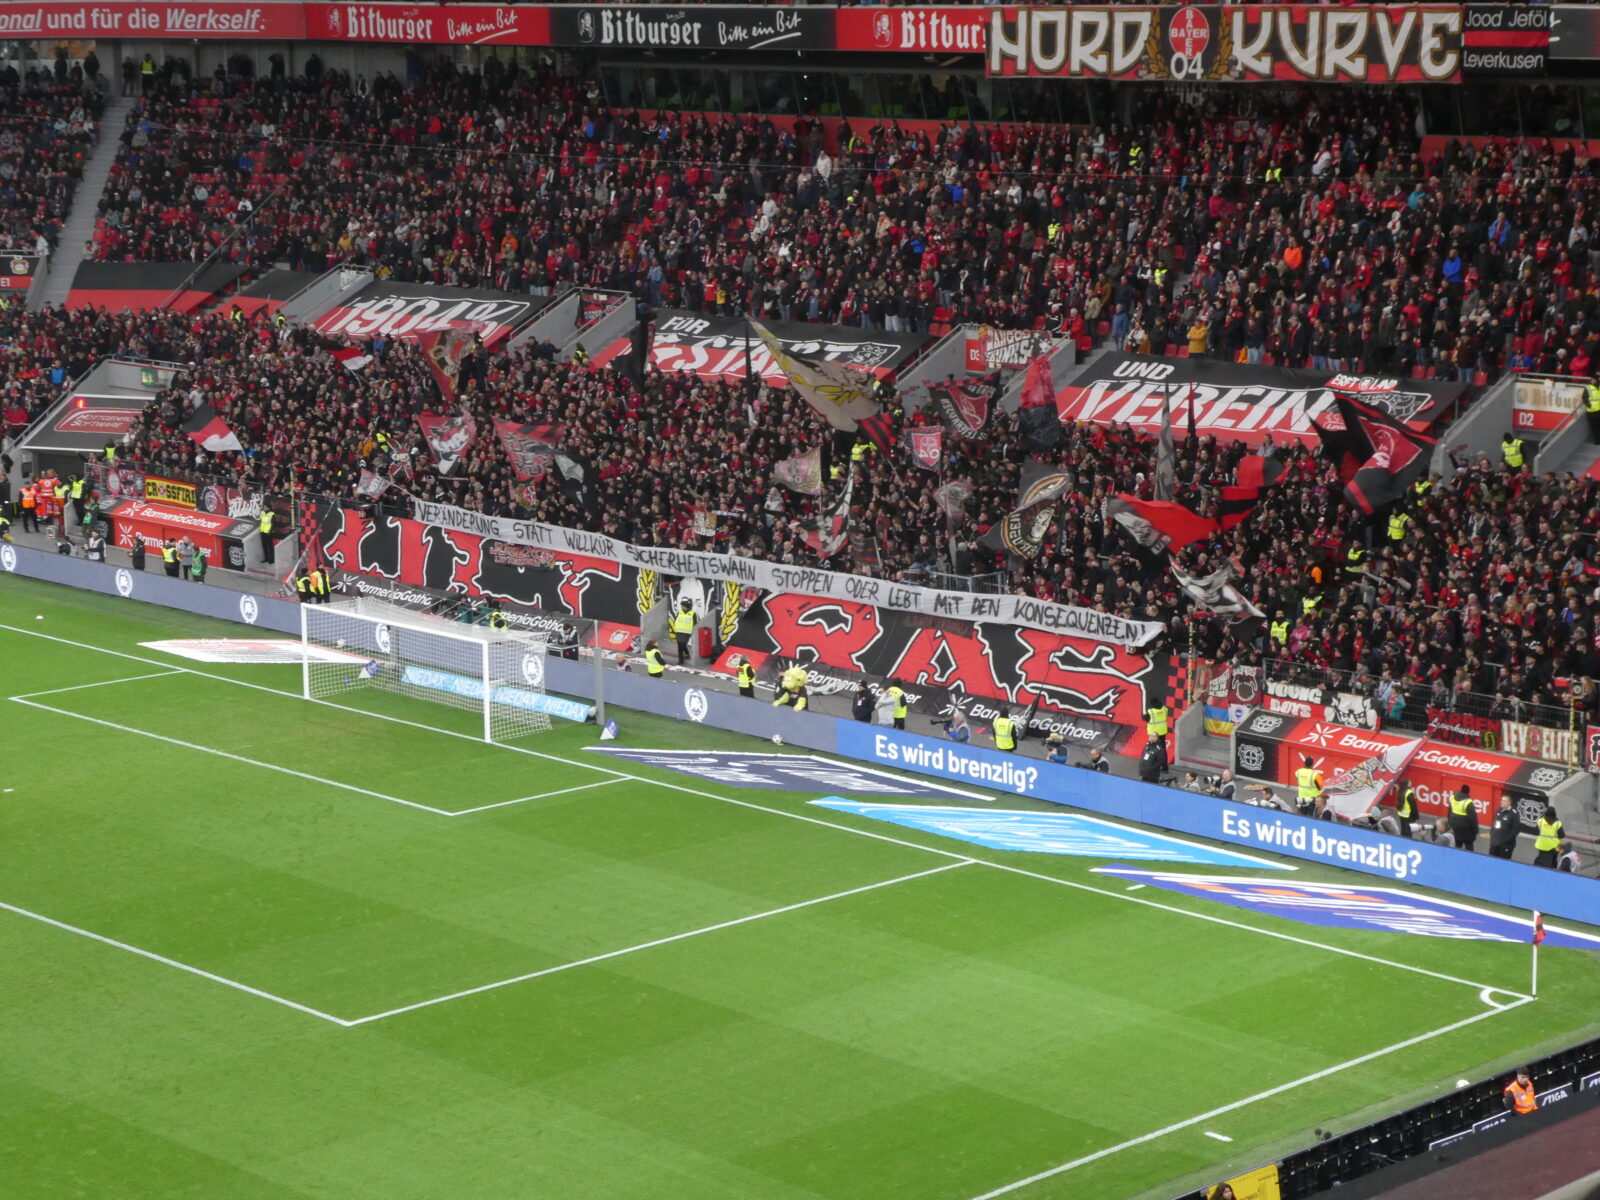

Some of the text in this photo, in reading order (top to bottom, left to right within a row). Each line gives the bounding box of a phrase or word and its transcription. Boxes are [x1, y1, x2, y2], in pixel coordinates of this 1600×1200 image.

[47, 9, 85, 30] und
[91, 8, 122, 29] für
[128, 9, 160, 30] die
[347, 7, 432, 40] Bitburger
[447, 8, 518, 40] Bitte ein Bit
[601, 9, 702, 45] Bitburger
[718, 10, 802, 45] Bitte ein Bit
[1170, 52, 1204, 80] 04
[1463, 52, 1544, 70] Leverkusen
[660, 316, 711, 335] FÜR
[1112, 361, 1176, 381] UND
[417, 502, 500, 537] VERÄNDERUNG
[512, 521, 553, 546] STATT
[770, 567, 835, 594] STOPPEN
[845, 577, 880, 601] ODER
[887, 586, 923, 609] LEBT
[970, 597, 1000, 617] DEN
[1265, 680, 1322, 705] YOUNG
[1270, 698, 1312, 718] BOYS
[875, 734, 899, 761] Es
[902, 743, 944, 770] wird
[947, 749, 1039, 793] brenzlig?
[1222, 809, 1251, 838] Es
[1255, 820, 1307, 851] wird
[1311, 828, 1423, 879] brenzlig?
